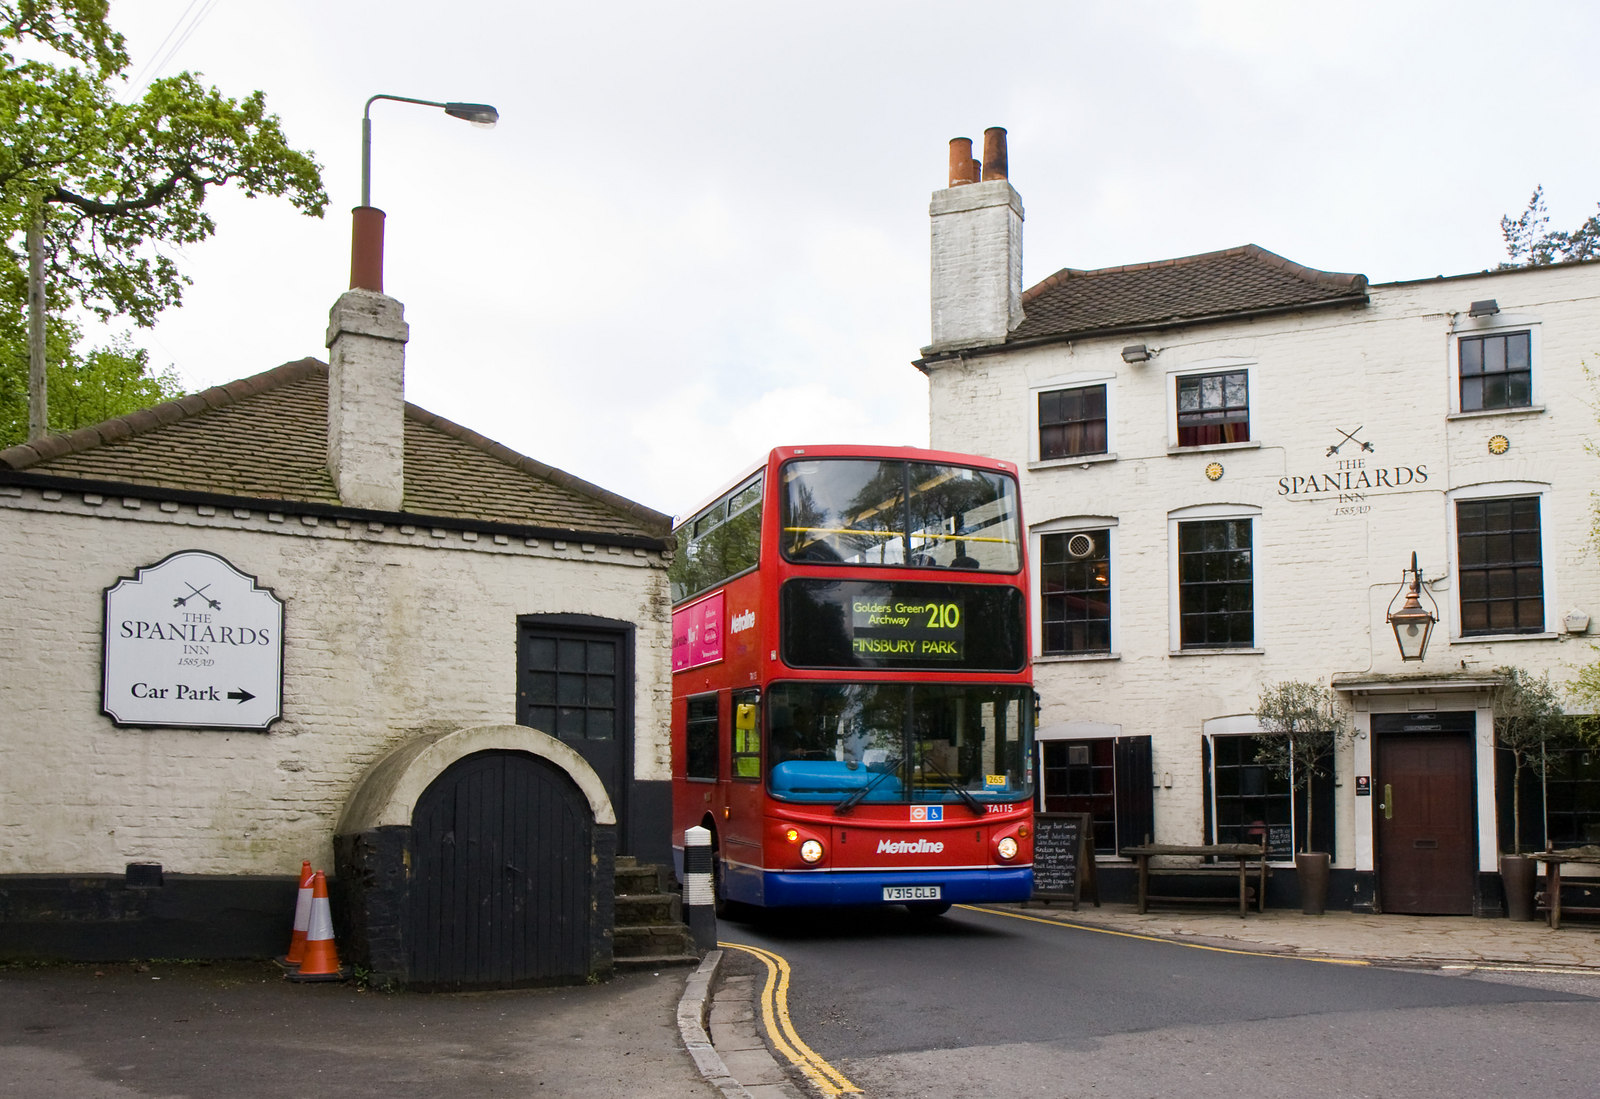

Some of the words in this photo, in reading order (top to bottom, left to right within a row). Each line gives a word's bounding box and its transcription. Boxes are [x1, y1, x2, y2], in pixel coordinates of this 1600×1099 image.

[1336, 459, 1366, 470] THE
[1277, 464, 1428, 495] SPANIARDS
[1339, 493, 1366, 504] INN
[1334, 506, 1354, 516] 1585
[853, 602, 891, 613] Golders
[895, 603, 924, 614] Green
[182, 612, 212, 624] THE
[731, 609, 755, 634] Metroline
[868, 614, 909, 627] Archway
[926, 603, 960, 628] 210
[120, 620, 270, 646] SPANIARDS
[183, 644, 210, 655] INN
[853, 639, 917, 653] FINSBURY
[922, 640, 957, 654] PARK
[178, 658, 199, 667] 1585
[131, 682, 169, 699] Car
[176, 684, 220, 701] Park
[988, 775, 1004, 785] 265
[987, 805, 1013, 813] TA115
[877, 839, 944, 853] Metroline
[886, 888, 912, 899] V315
[915, 887, 937, 898] GLB
